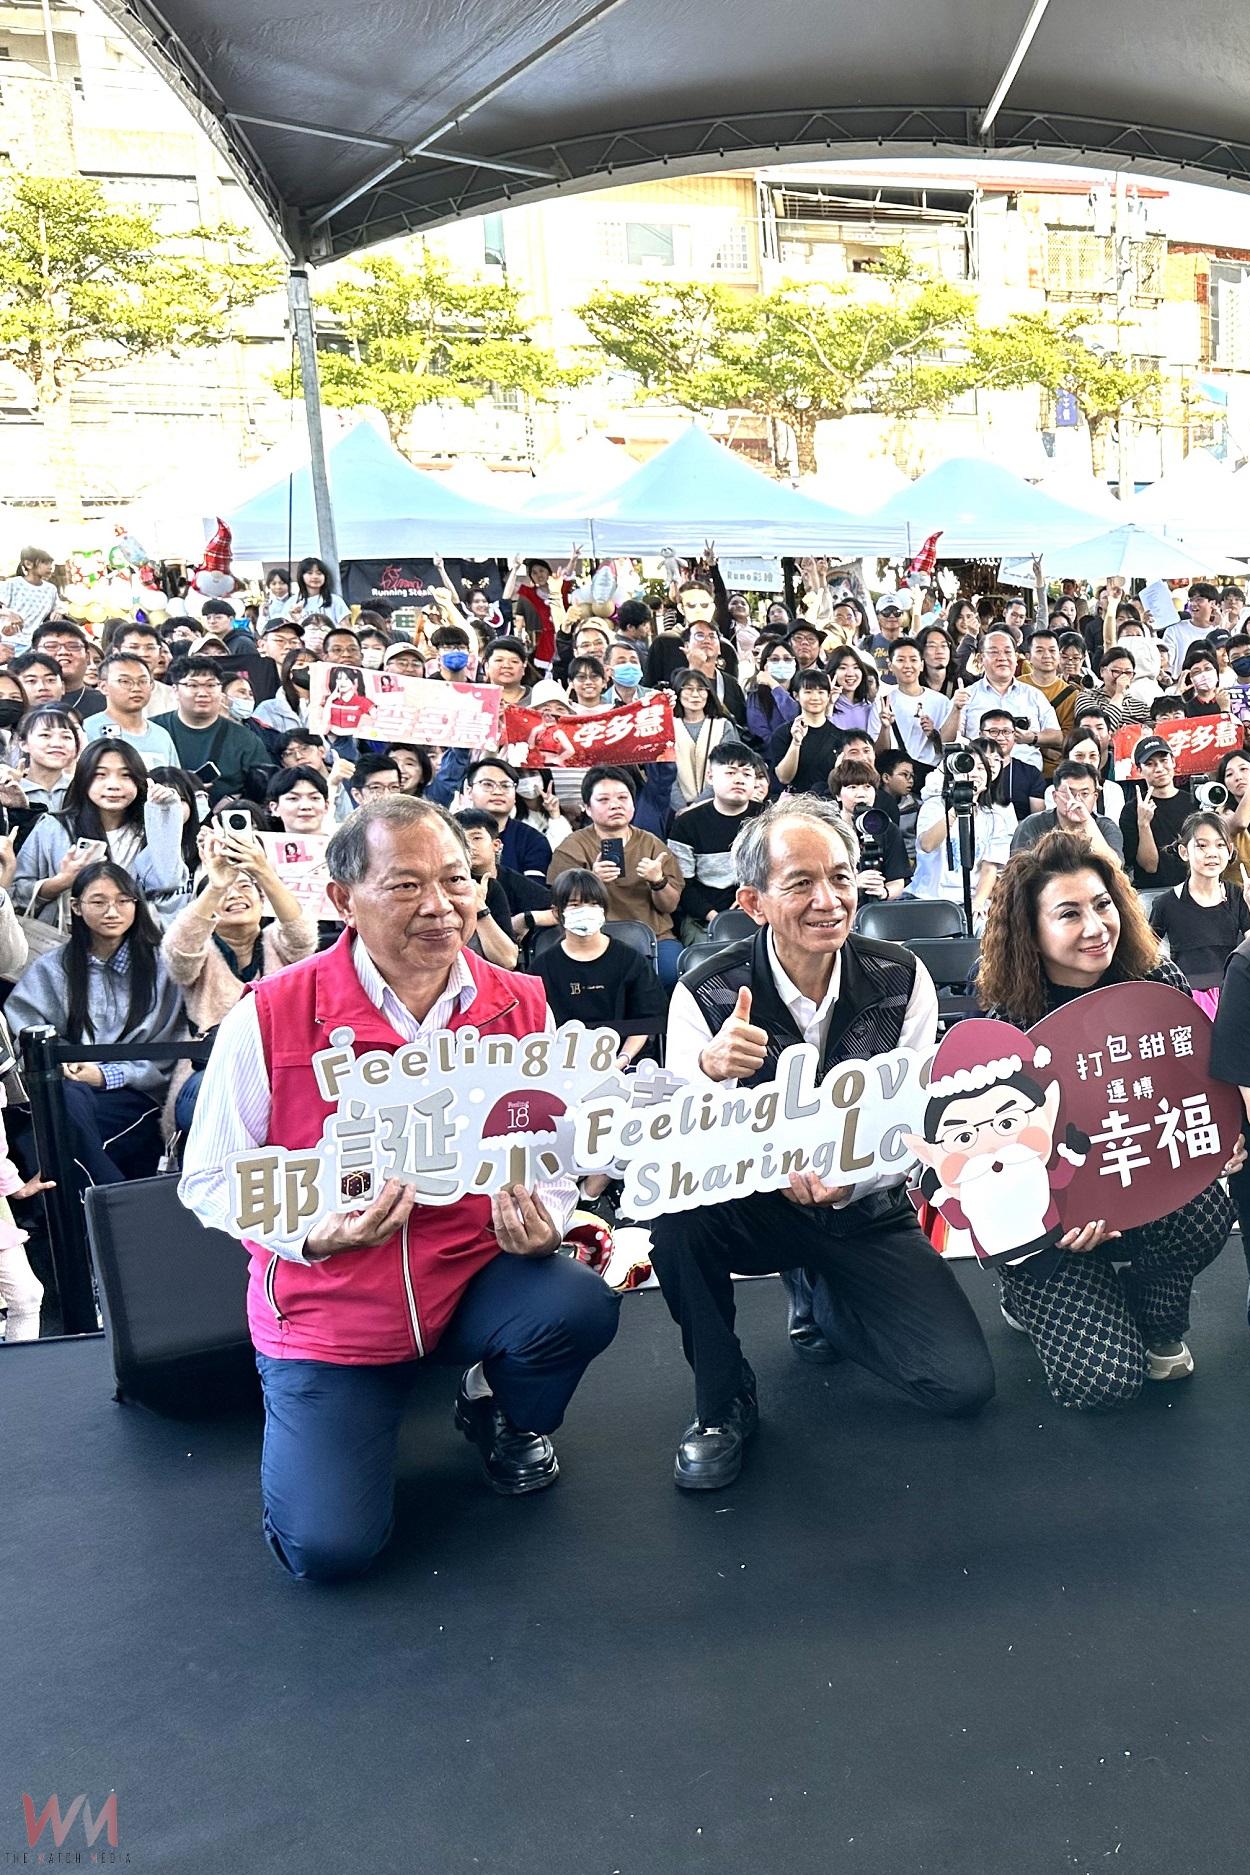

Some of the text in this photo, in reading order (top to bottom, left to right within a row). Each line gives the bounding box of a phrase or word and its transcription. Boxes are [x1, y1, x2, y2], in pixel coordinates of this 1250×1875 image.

[371, 588, 408, 598] Running
[573, 703, 665, 749] 李多慧
[1167, 720, 1238, 759] 李多慧
[1075, 1025, 1194, 1081] 打包甜蜜
[1106, 1075, 1154, 1104] 運轉
[507, 1107, 530, 1129] 18
[1089, 1092, 1222, 1188] 幸福
